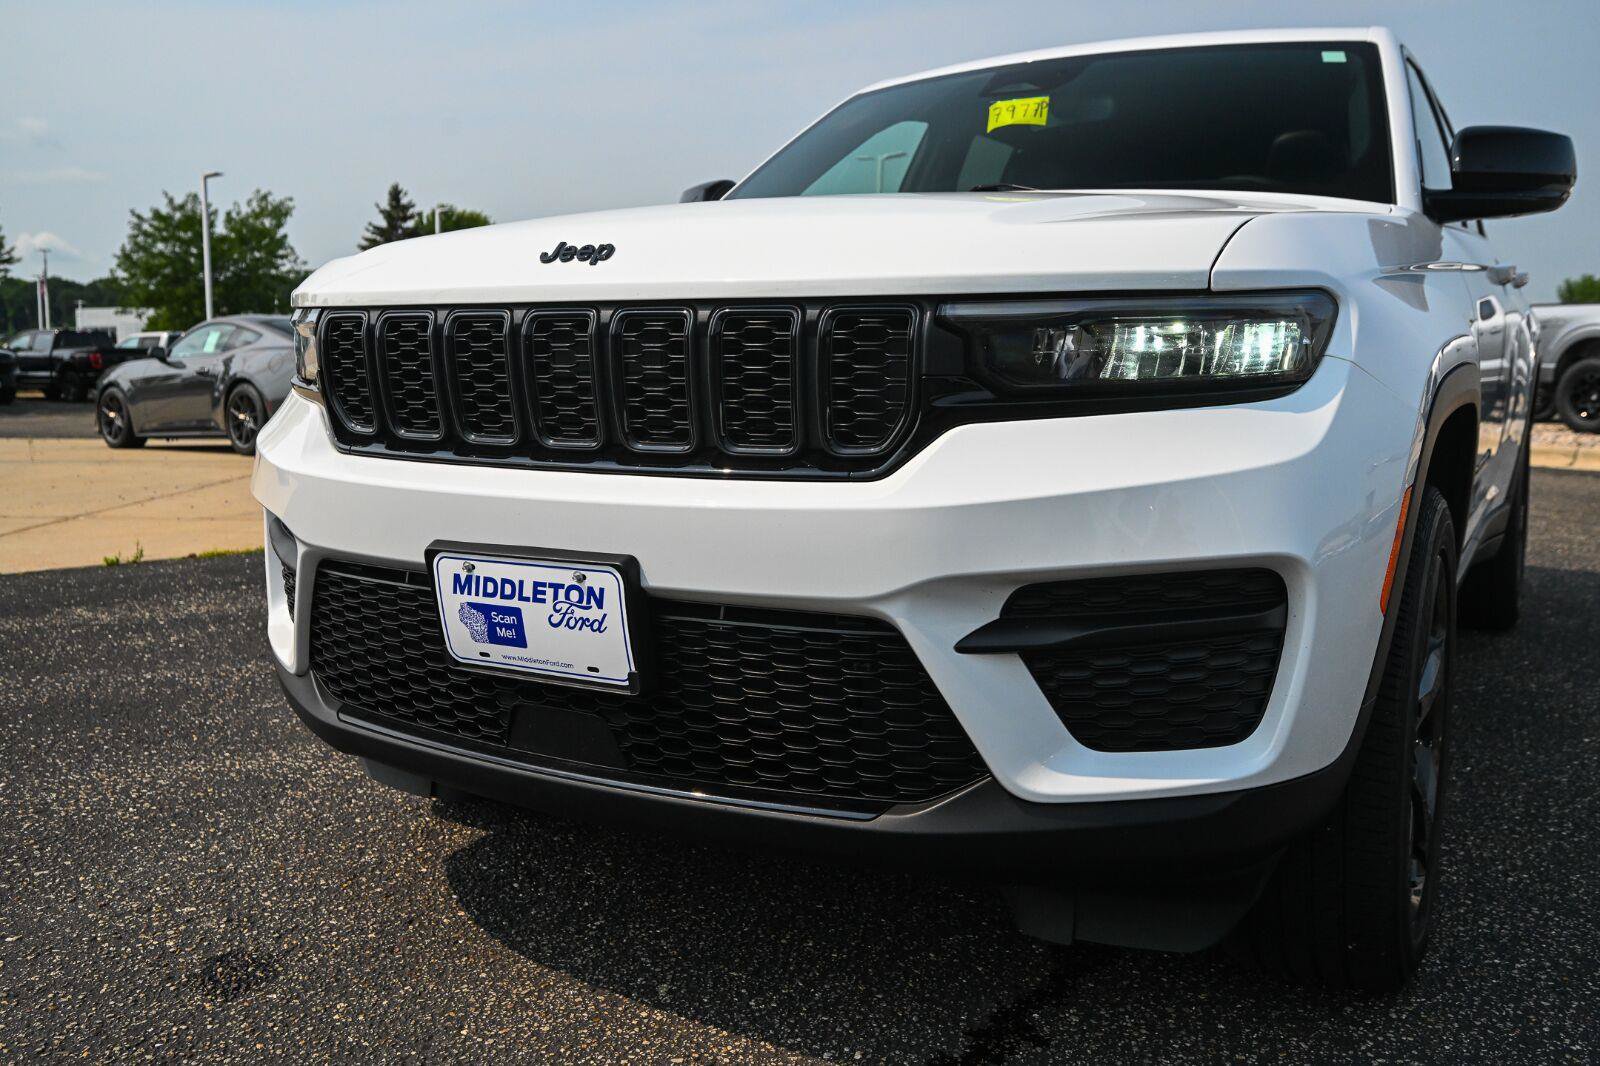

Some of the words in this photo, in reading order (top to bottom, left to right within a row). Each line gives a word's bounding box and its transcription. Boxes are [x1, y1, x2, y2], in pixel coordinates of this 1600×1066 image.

[539, 241, 616, 266] Jeep
[452, 573, 605, 610] MIDDLETON
[491, 611, 518, 625] Scan
[547, 600, 608, 634] Ford
[496, 627, 516, 639] Me!
[501, 654, 574, 669] www.MiddletonFord.com
